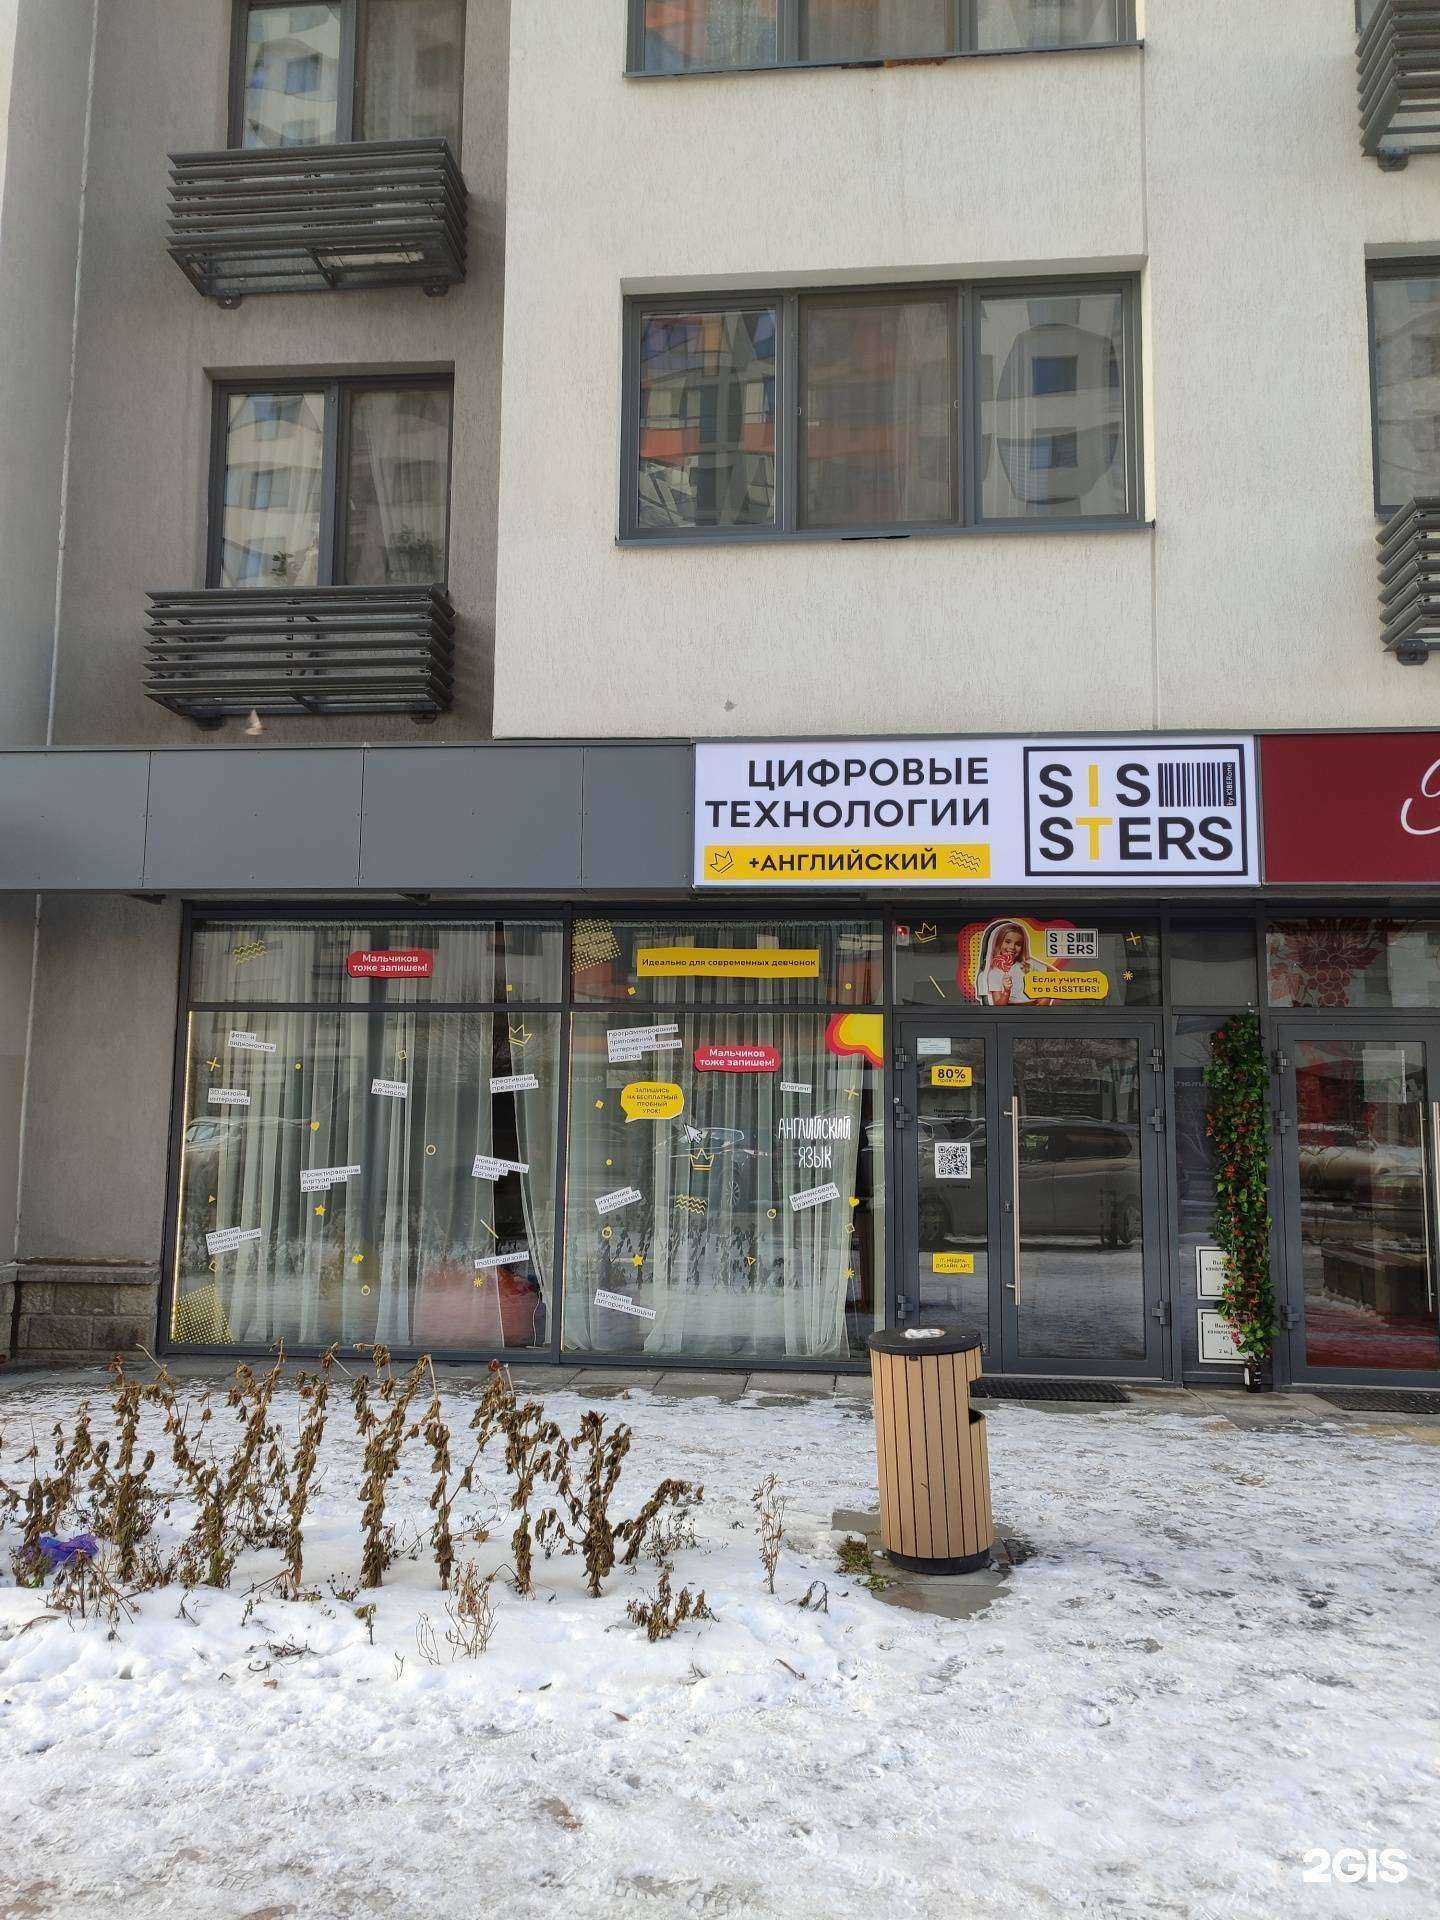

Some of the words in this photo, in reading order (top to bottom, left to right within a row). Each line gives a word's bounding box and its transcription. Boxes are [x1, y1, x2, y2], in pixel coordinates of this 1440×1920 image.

[748, 757, 990, 791] ЦИФРОВЫЕ
[704, 797, 990, 829] ТЕХНОЛОГИИ
[1038, 815, 1234, 862] STERS
[748, 847, 938, 872] +АНГЛИЙСКИЙ
[1049, 932, 1076, 943] SS
[1049, 944, 1095, 955] SERS
[362, 953, 419, 963] Мальчиков
[642, 958, 687, 967] Идеально
[688, 959, 706, 968] для
[708, 959, 769, 967] современных
[771, 959, 816, 968] девчонок
[353, 964, 378, 972] тоже
[380, 963, 428, 972] запишем!
[1059, 976, 1101, 985] учиться,
[1053, 985, 1100, 993] SISSTERS!
[709, 1048, 765, 1057] Мальчиков
[727, 1058, 775, 1067] запишем!
[937, 1068, 966, 1079] 80%
[779, 1114, 851, 1140] АНГЛИЙСКИЙ
[798, 1146, 832, 1168] ЯЗЫК
